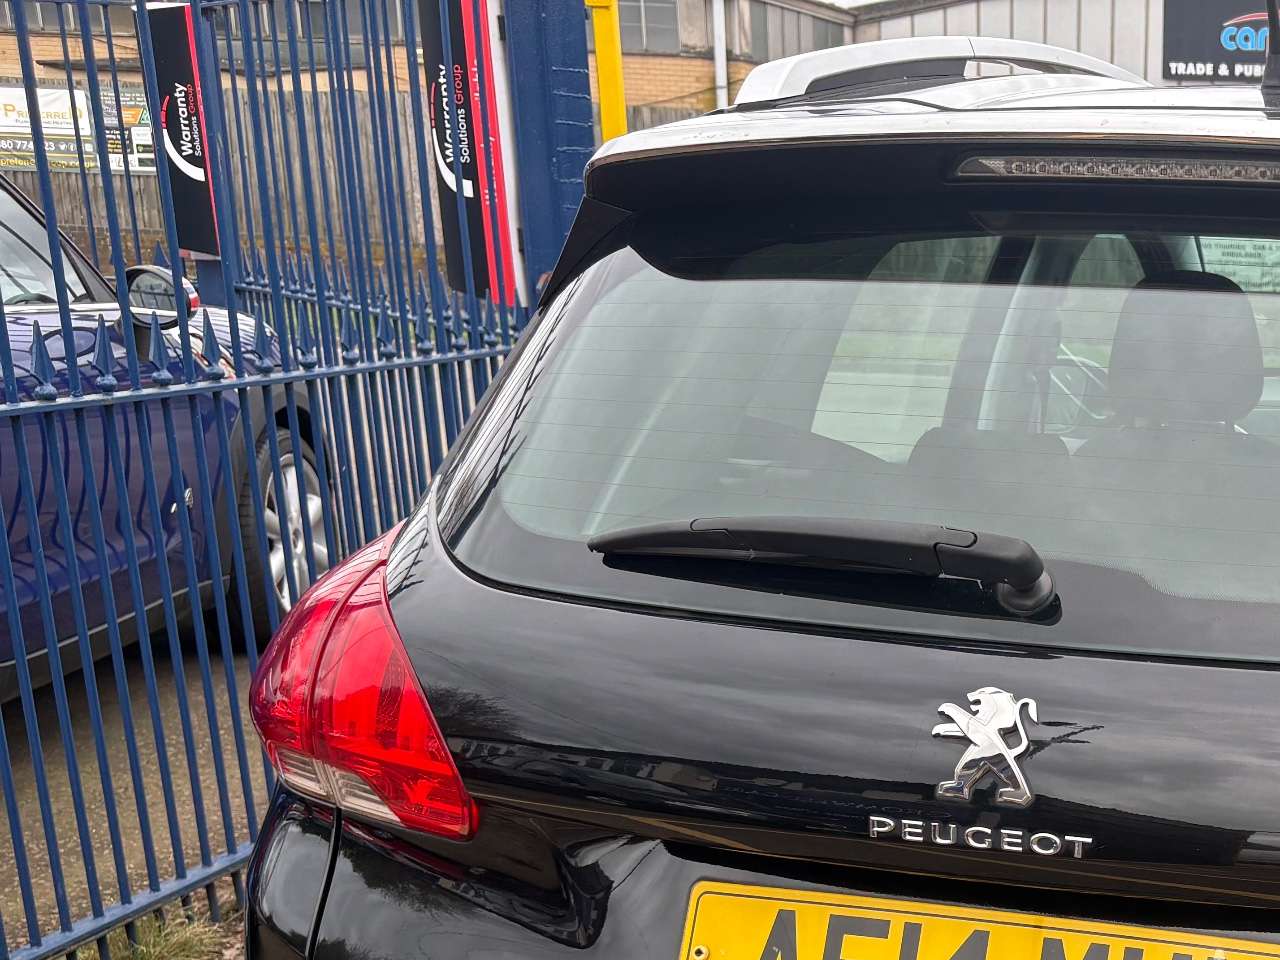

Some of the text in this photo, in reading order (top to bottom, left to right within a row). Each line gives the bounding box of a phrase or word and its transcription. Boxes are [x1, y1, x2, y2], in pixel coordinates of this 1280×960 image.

[1169, 62, 1214, 76] TRADE
[1217, 63, 1230, 76] &
[1234, 64, 1265, 77] PUB
[174, 82, 194, 156] Warranty
[186, 84, 202, 157] Solutions Group
[453, 64, 470, 164] Solutions Group
[869, 816, 1093, 859] PEUGEOT
